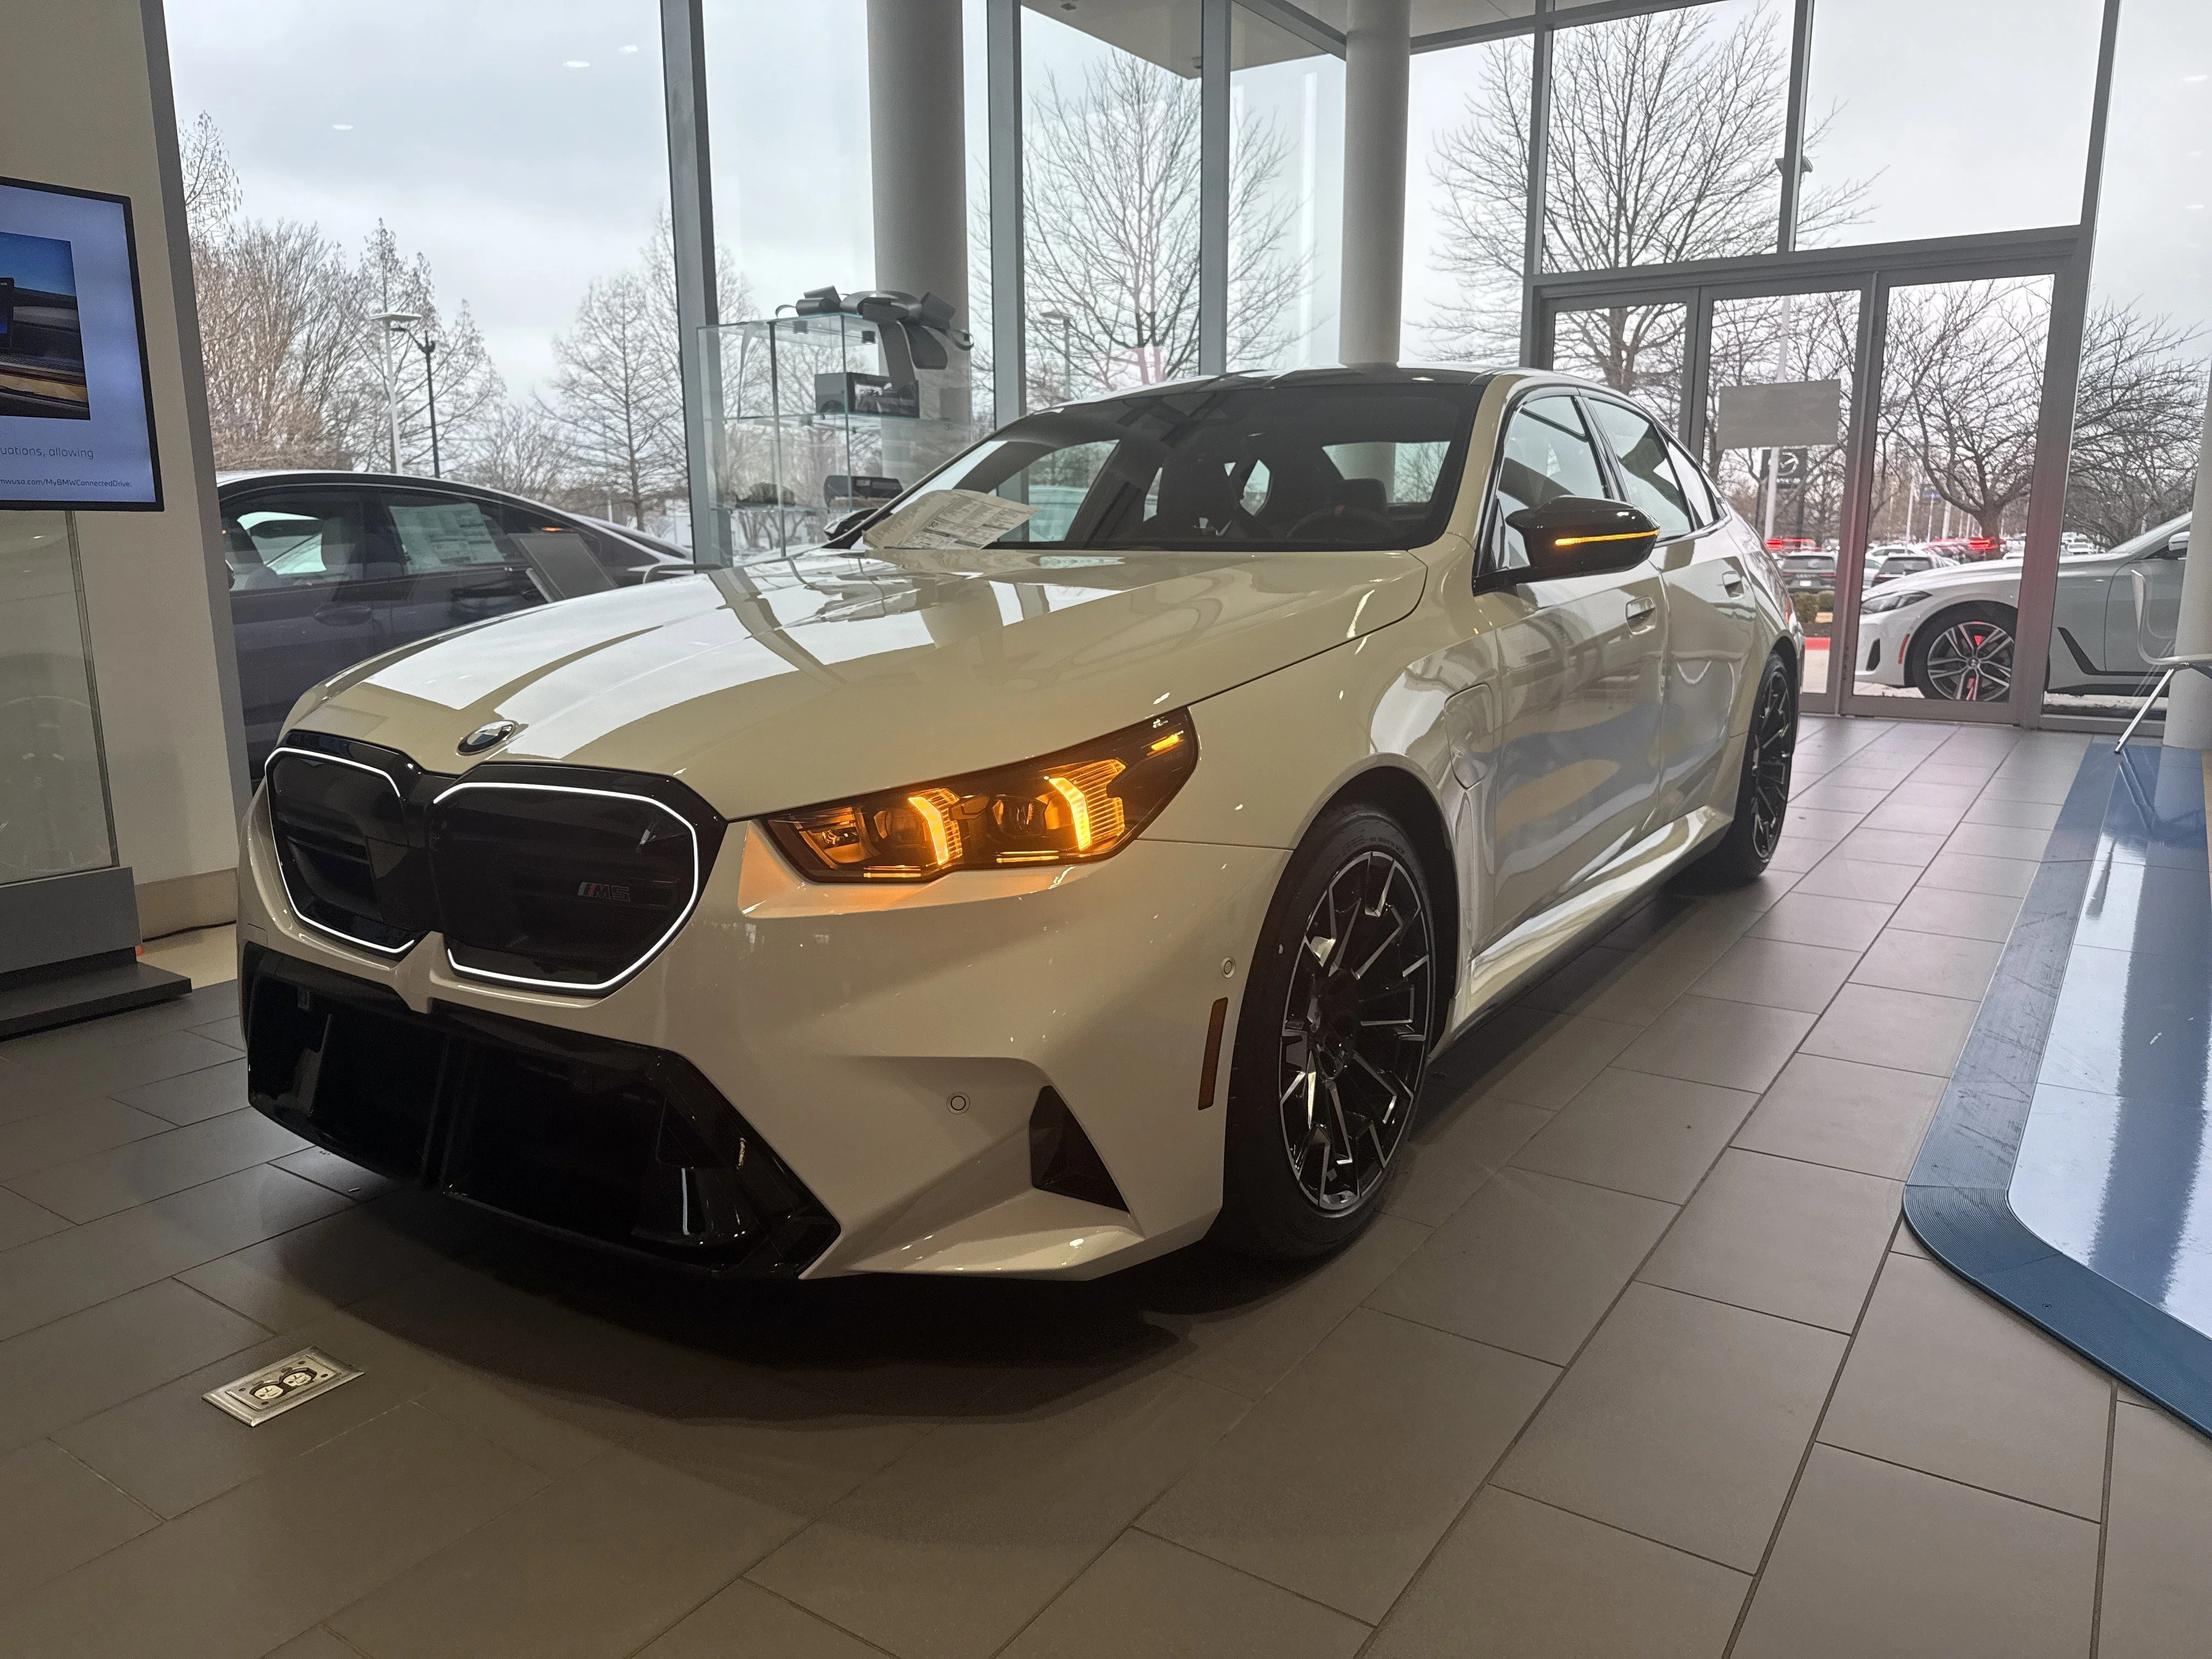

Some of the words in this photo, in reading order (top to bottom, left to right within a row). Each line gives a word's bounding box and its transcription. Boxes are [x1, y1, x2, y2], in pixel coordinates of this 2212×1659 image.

[0, 446, 46, 458] uations,
[48, 447, 94, 460] allowing
[591, 882, 631, 902] M5
